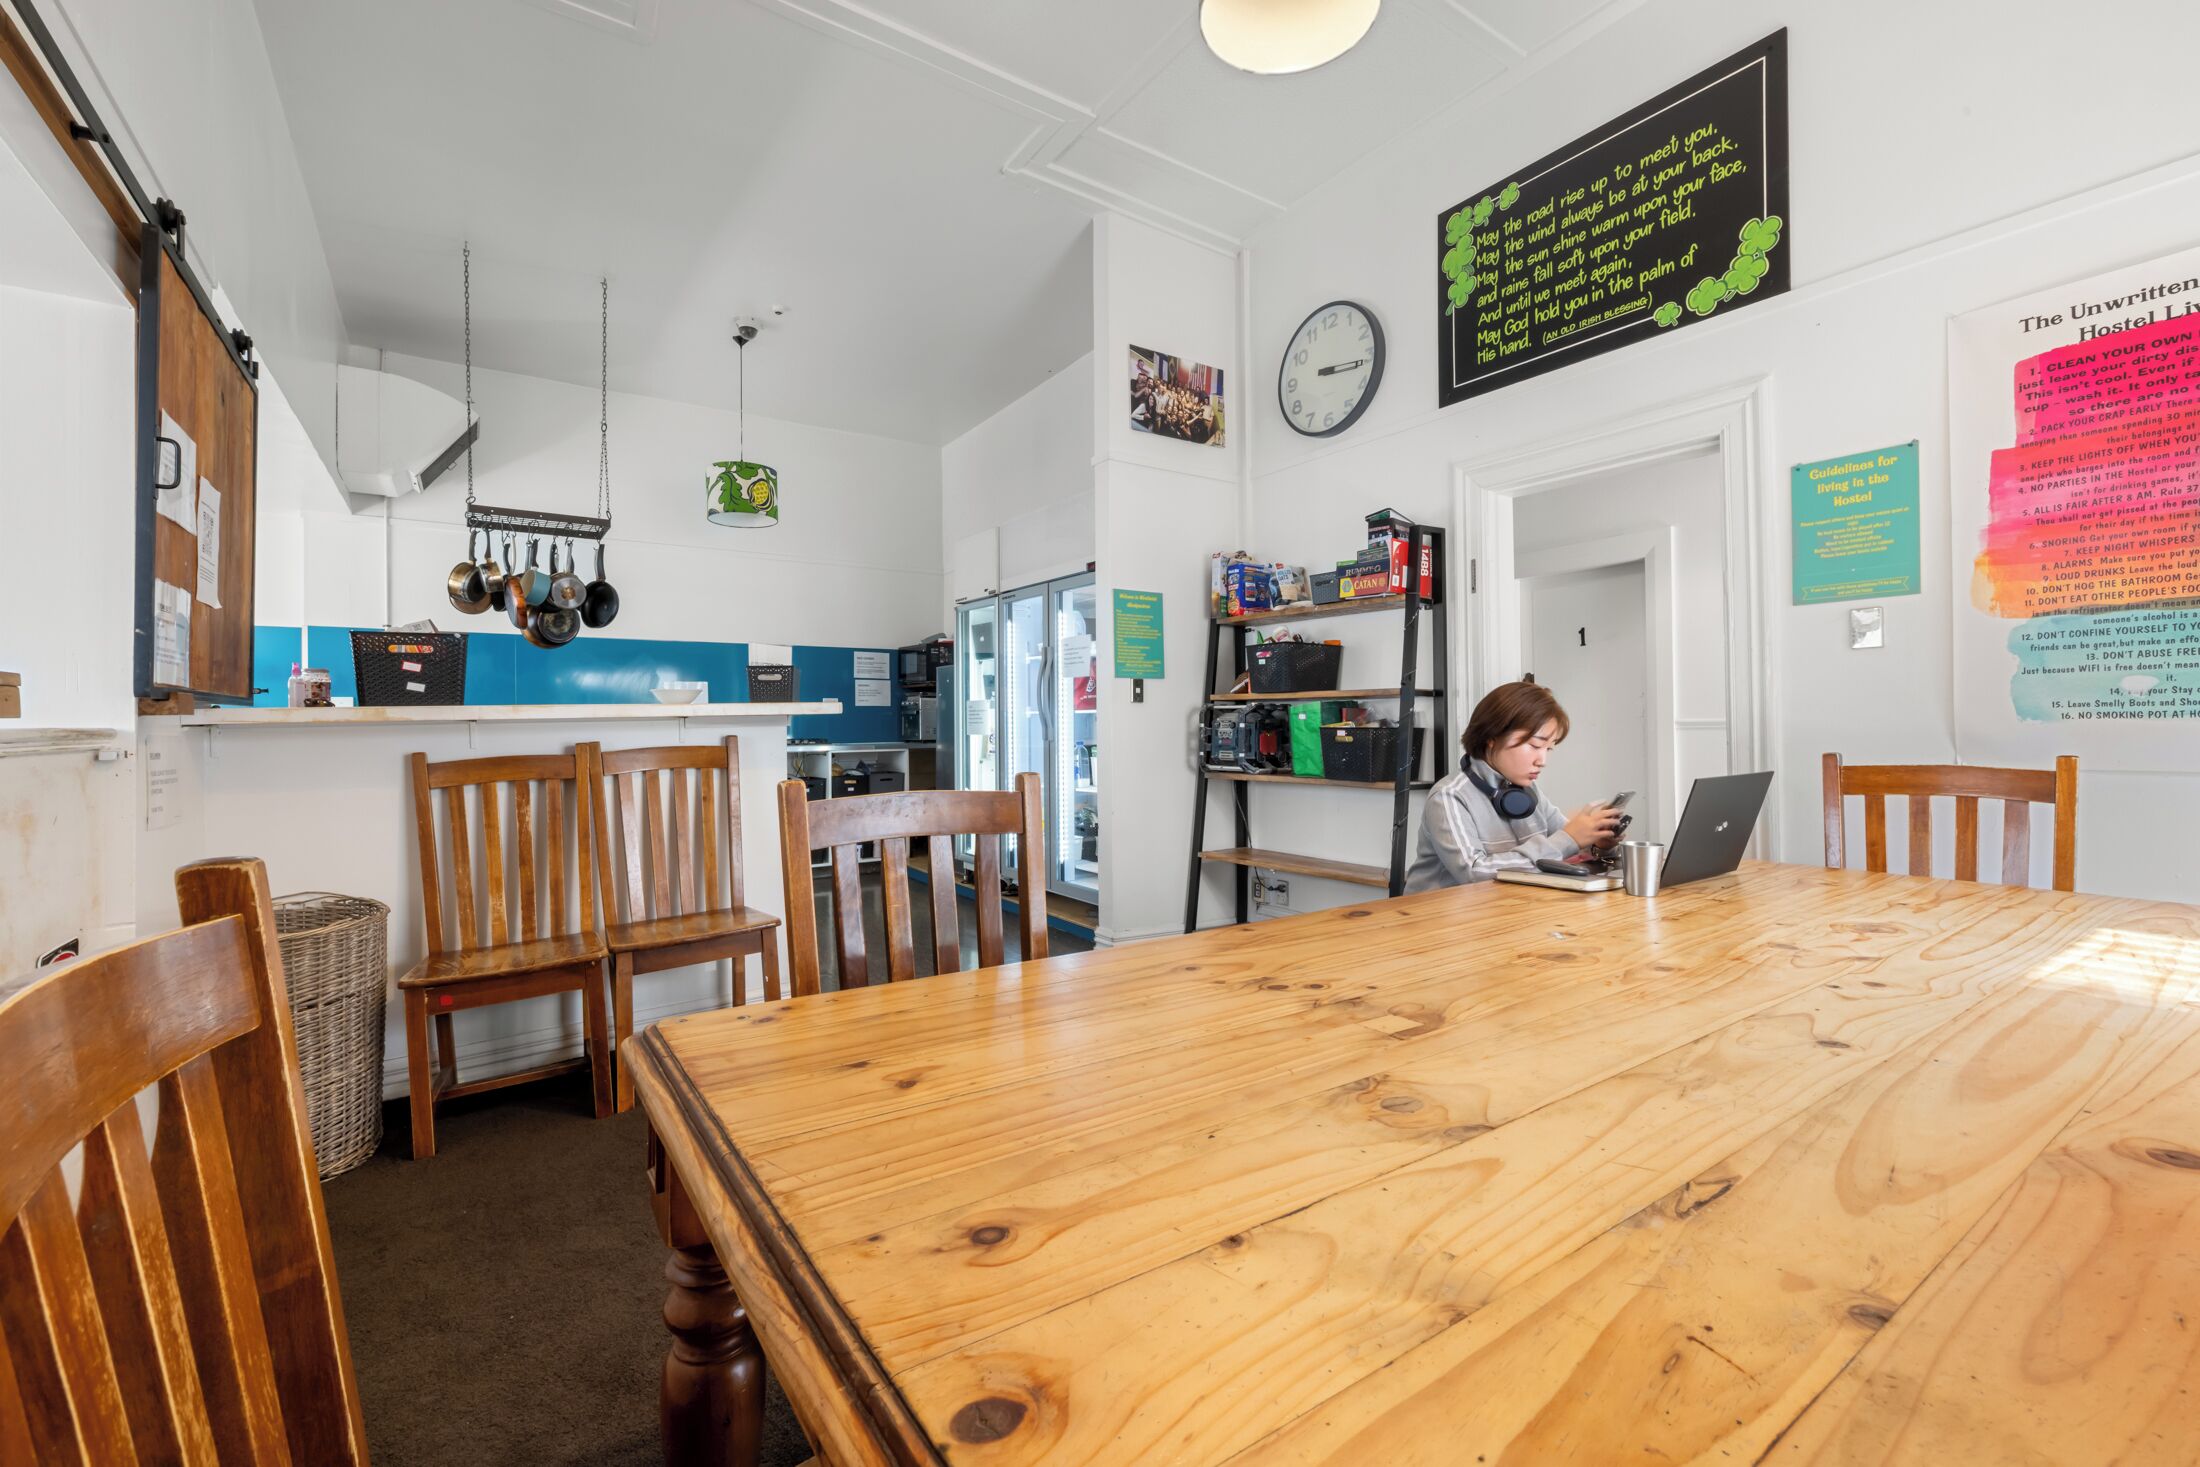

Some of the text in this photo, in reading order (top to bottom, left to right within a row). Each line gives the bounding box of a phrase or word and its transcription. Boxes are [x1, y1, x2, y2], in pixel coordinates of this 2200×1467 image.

[1477, 230, 1499, 250] May
[1503, 217, 1522, 236] the
[1527, 196, 1554, 225] road
[1561, 189, 1584, 208] rise
[1591, 177, 1608, 195] up
[1614, 165, 1632, 180] to
[1640, 135, 1679, 169] meet
[1477, 136, 1738, 268] May the wind always be at your back.
[1477, 160, 1746, 288] May the sun shine warm upon your face,
[1477, 199, 1696, 307] and rains fall soft upon your field.
[1478, 254, 1632, 327] And until we meet again,
[1478, 243, 1698, 347] May God hold you in the palm of
[2018, 277, 2200, 333] The Unwritten
[1322, 312, 1338, 330] 12
[1347, 312, 1352, 326] 1
[1561, 323, 1576, 335] OLD
[1579, 314, 1601, 329] IRISH
[2079, 311, 2156, 342] Hostel
[1307, 327, 1317, 344] 11
[1358, 323, 1369, 340] 2
[1478, 330, 1532, 365] His hand.
[2047, 354, 2096, 372] CLEAN
[2102, 344, 2145, 360] YOUR
[2151, 332, 2192, 349] OWN
[1293, 350, 1308, 366] 10
[2018, 380, 2045, 392] just
[2050, 371, 2086, 383] leave
[2092, 362, 2126, 376] your
[2131, 352, 2169, 368] dirty
[2025, 358, 2195, 400] This isn't cool. Even if
[1288, 378, 1297, 393] 9
[2024, 403, 2048, 413] cup
[2065, 391, 2102, 404] wash
[2108, 385, 2123, 395] it.
[2129, 381, 2140, 391] It
[2146, 375, 2178, 389] only
[1292, 400, 1302, 415] 8
[1344, 398, 1353, 415] 5
[2069, 386, 2189, 416] so there are no
[1306, 412, 1315, 428] 7
[1324, 412, 1334, 427] 6
[2032, 459, 2054, 470] KEEP
[2058, 456, 2074, 464] THE
[2078, 449, 2112, 461] LIGHTS
[2117, 443, 2134, 453] OFF
[2139, 438, 2170, 450] WHEN
[1809, 455, 1898, 481] Guidelines for
[1817, 473, 1889, 494] living in the
[1834, 491, 1872, 507] Hostel
[1421, 549, 1429, 577] 1488
[2055, 571, 2080, 580] LOUD
[2085, 567, 2125, 578] DRUNKS
[2129, 564, 2155, 574] Leave
[2159, 562, 2173, 570] the
[2177, 560, 2198, 569] loud
[1354, 579, 1377, 590] CATAN
[2042, 583, 2070, 593] DON'T
[2074, 581, 2095, 591] HOG
[2099, 580, 2116, 588] THE
[2122, 573, 2181, 587] BATHROOM
[2038, 596, 2066, 605] DON'T
[2070, 594, 2087, 603] EAT
[2091, 591, 2125, 601] OTHER
[2129, 586, 2177, 598] PEOPLE'S
[1578, 627, 1586, 646] 1
[2038, 631, 2065, 640] DON'T
[2069, 628, 2111, 639] CONFINE
[2115, 624, 2168, 635] YOURSELF
[2172, 623, 2186, 631] TO
[2103, 650, 2132, 659] DON'T
[2137, 648, 2172, 658] ABUSE
[2078, 664, 2100, 672] WIFI
[2115, 663, 2133, 671] free
[2137, 662, 2171, 670] doesn't
[2095, 700, 2125, 709] Smelly
[2129, 699, 2155, 707] Boots
[2159, 698, 2175, 706] and
[2078, 712, 2092, 720] NO
[2096, 711, 2144, 719] SMOKING
[2148, 710, 2168, 718] POT
[2172, 710, 2185, 718] AT
